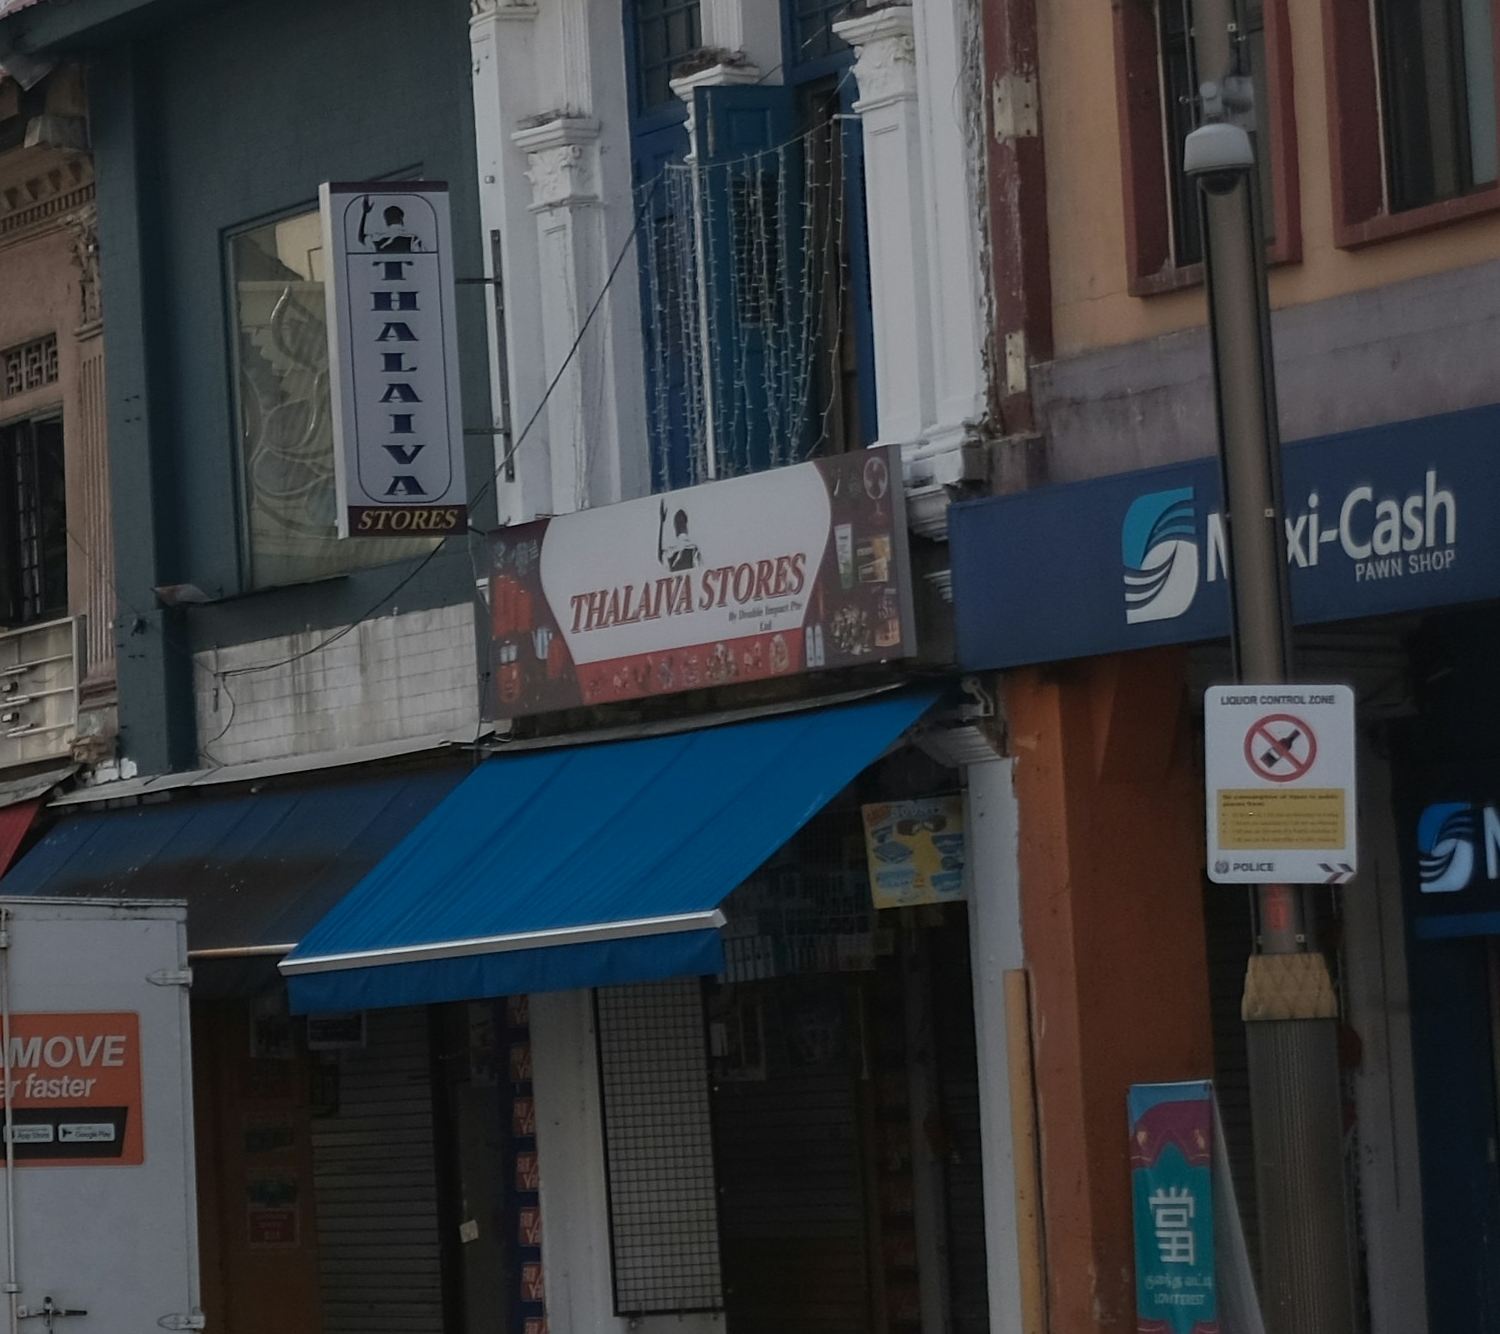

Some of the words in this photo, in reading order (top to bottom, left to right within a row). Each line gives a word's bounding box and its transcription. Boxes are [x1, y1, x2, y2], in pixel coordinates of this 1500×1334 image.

[370, 260, 428, 496] THALAIVA
[358, 509, 458, 530] STORES
[1207, 469, 1456, 582] xi-Cash
[1355, 560, 1403, 582] PAWN
[1409, 549, 1456, 575] SHOP
[569, 573, 696, 634] THALAIVA
[699, 553, 806, 611] STORES
[1220, 695, 1258, 706] LIQUOR
[1259, 694, 1306, 705] CONTROL
[1308, 694, 1335, 705] ZONE
[1233, 862, 1275, 873] POLICE
[25, 1072, 96, 1098] faster
